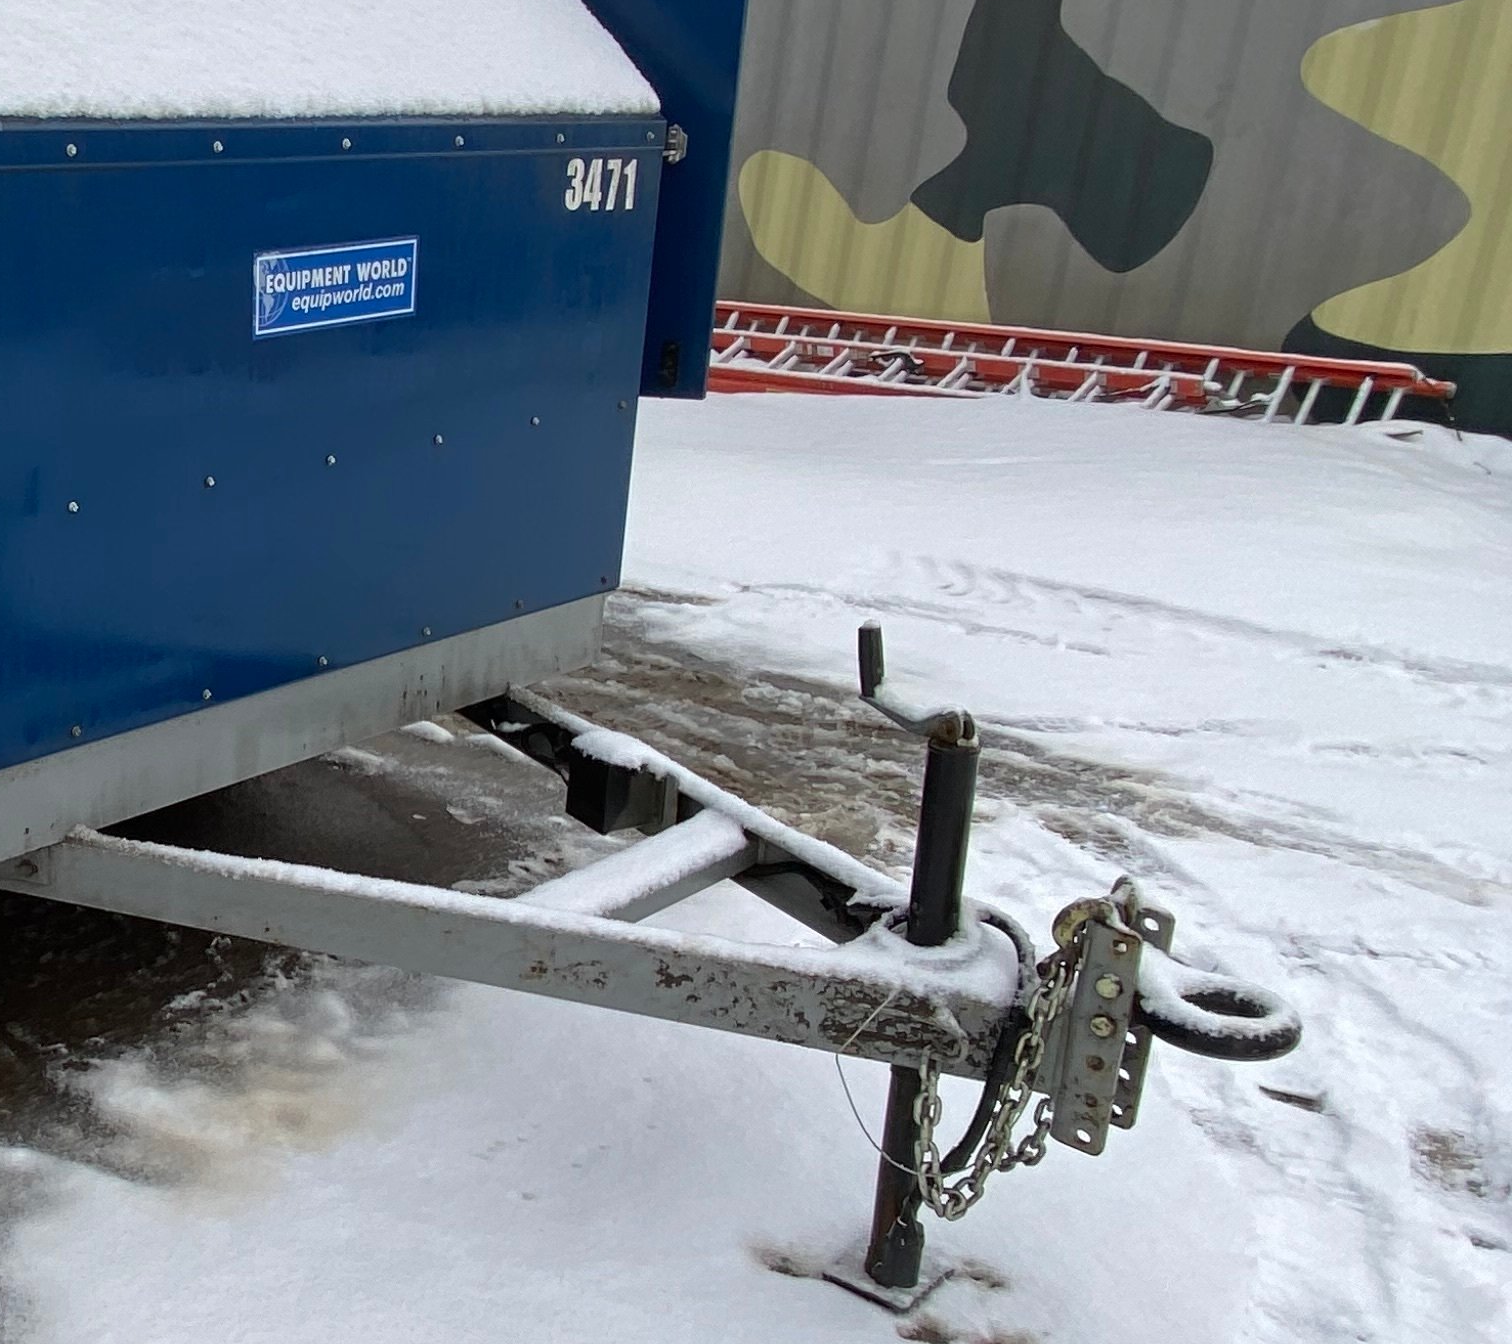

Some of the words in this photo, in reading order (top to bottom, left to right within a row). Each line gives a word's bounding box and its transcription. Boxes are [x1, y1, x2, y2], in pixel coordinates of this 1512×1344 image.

[565, 158, 637, 211] 3471
[265, 264, 351, 294] EQUIPMENT
[356, 257, 408, 282] WORLD
[291, 282, 405, 313] equipworld.com
